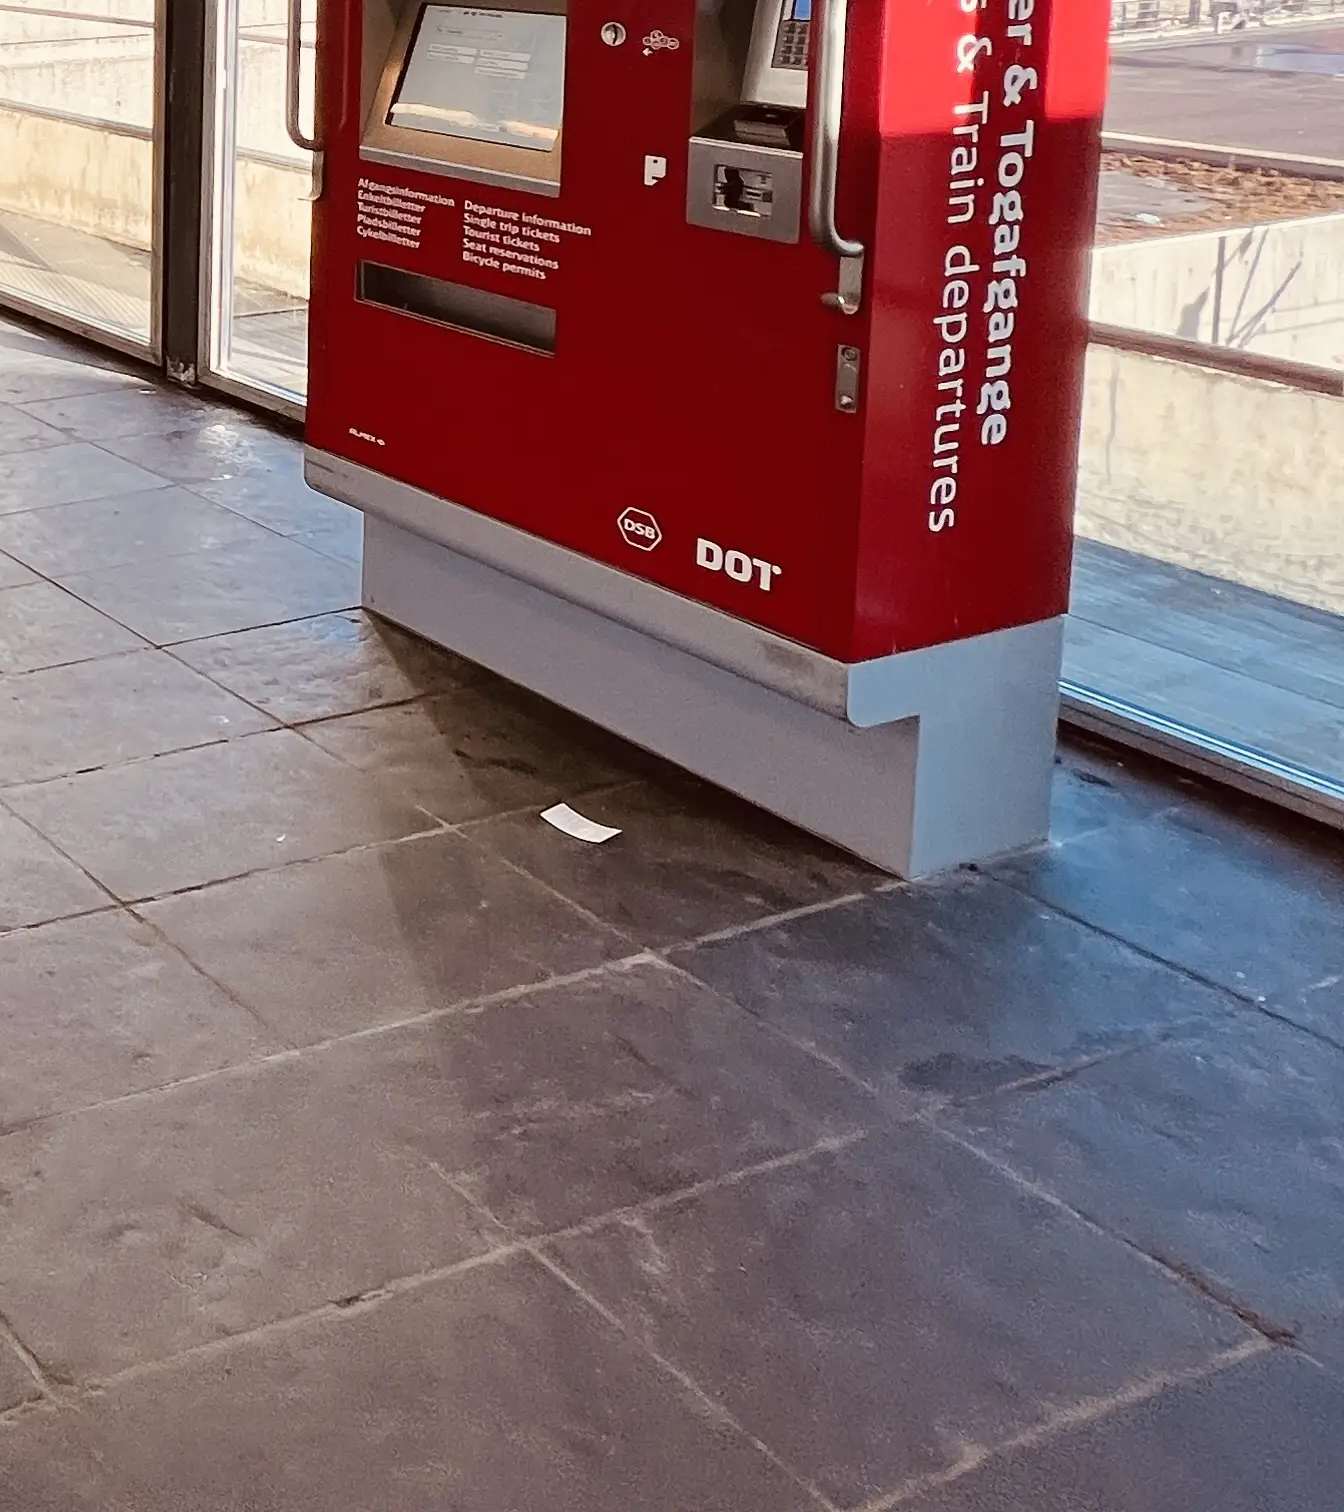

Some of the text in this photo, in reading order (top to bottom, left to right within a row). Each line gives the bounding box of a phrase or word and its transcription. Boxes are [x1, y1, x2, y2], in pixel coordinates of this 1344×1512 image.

[957, 33, 993, 74] &
[1003, 64, 1038, 107] &
[948, 90, 990, 225] Train
[357, 178, 455, 207] Afgangsinformation
[357, 190, 426, 213] Enkeltbilletter
[357, 202, 422, 225] Turistbilletter
[357, 214, 421, 237] Pladsbilletter
[464, 199, 592, 237] Departure information
[464, 213, 561, 244] Single trip tickets
[356, 226, 420, 249] Cykelbilletter
[463, 225, 540, 253] Tourist tickets
[462, 251, 547, 281] Bicycle permits
[463, 238, 560, 270] Seat reservations
[977, 119, 1035, 447] Togafgange
[928, 245, 980, 534] departures
[623, 518, 656, 540] DSB
[696, 537, 781, 592] DOT
